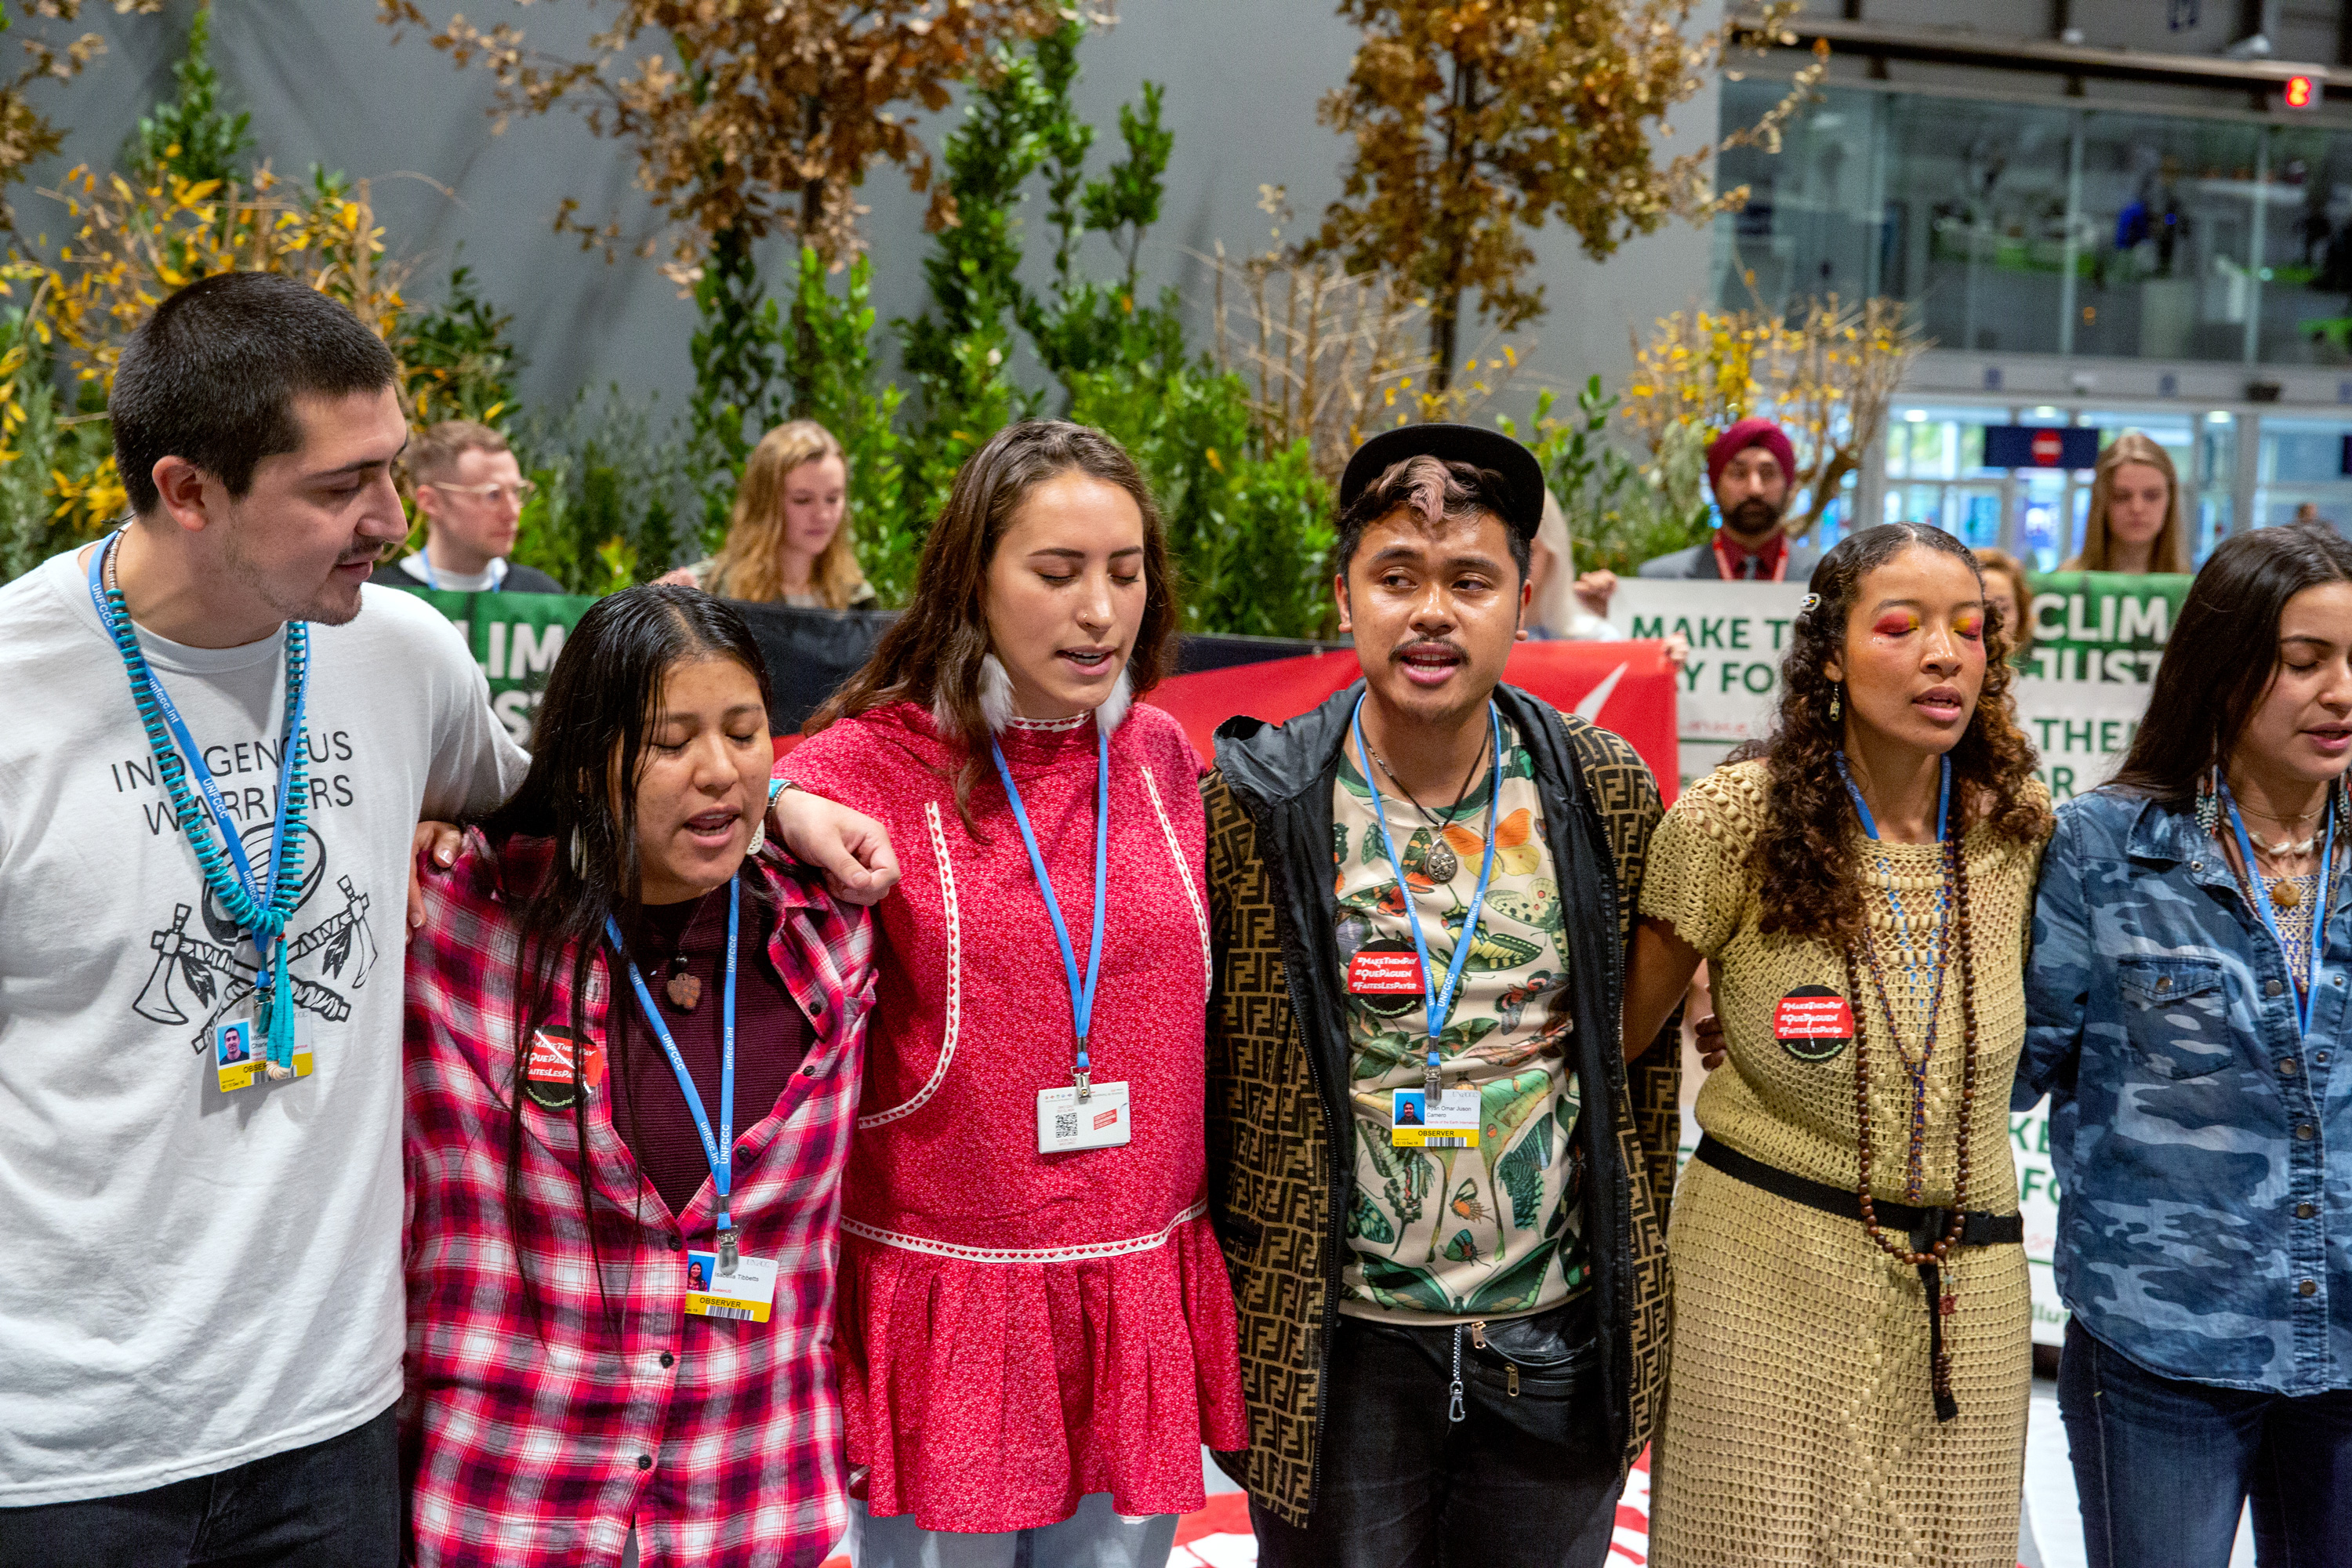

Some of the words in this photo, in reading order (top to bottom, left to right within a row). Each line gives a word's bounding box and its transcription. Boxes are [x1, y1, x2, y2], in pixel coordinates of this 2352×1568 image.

[92, 583, 115, 627] UNFCCC
[2031, 592, 2169, 644] CLIM
[1631, 615, 1751, 649] MAKE
[1765, 618, 1795, 650] T
[1721, 662, 1774, 695] FO
[2032, 718, 2137, 753] THE
[111, 731, 353, 792] INDGENUS
[201, 778, 229, 819] UNFCCC
[2038, 766, 2075, 800] R
[143, 775, 353, 836] WARRIRS
[243, 869, 260, 909] unfccc.in
[1402, 882, 1417, 917] UNFCCC
[1465, 890, 1483, 929] unfccc.int
[728, 935, 737, 973] UNFCCC
[1424, 966, 1435, 1007] unfccc.int
[1436, 972, 1456, 1007] UNFCCC
[662, 1033, 685, 1072] UNFCCC
[724, 1026, 734, 1070] unfccc.int
[700, 1121, 720, 1165] unfccc.int
[720, 1124, 730, 1164] UNFCCC
[699, 1297, 742, 1308] OBSERVER
